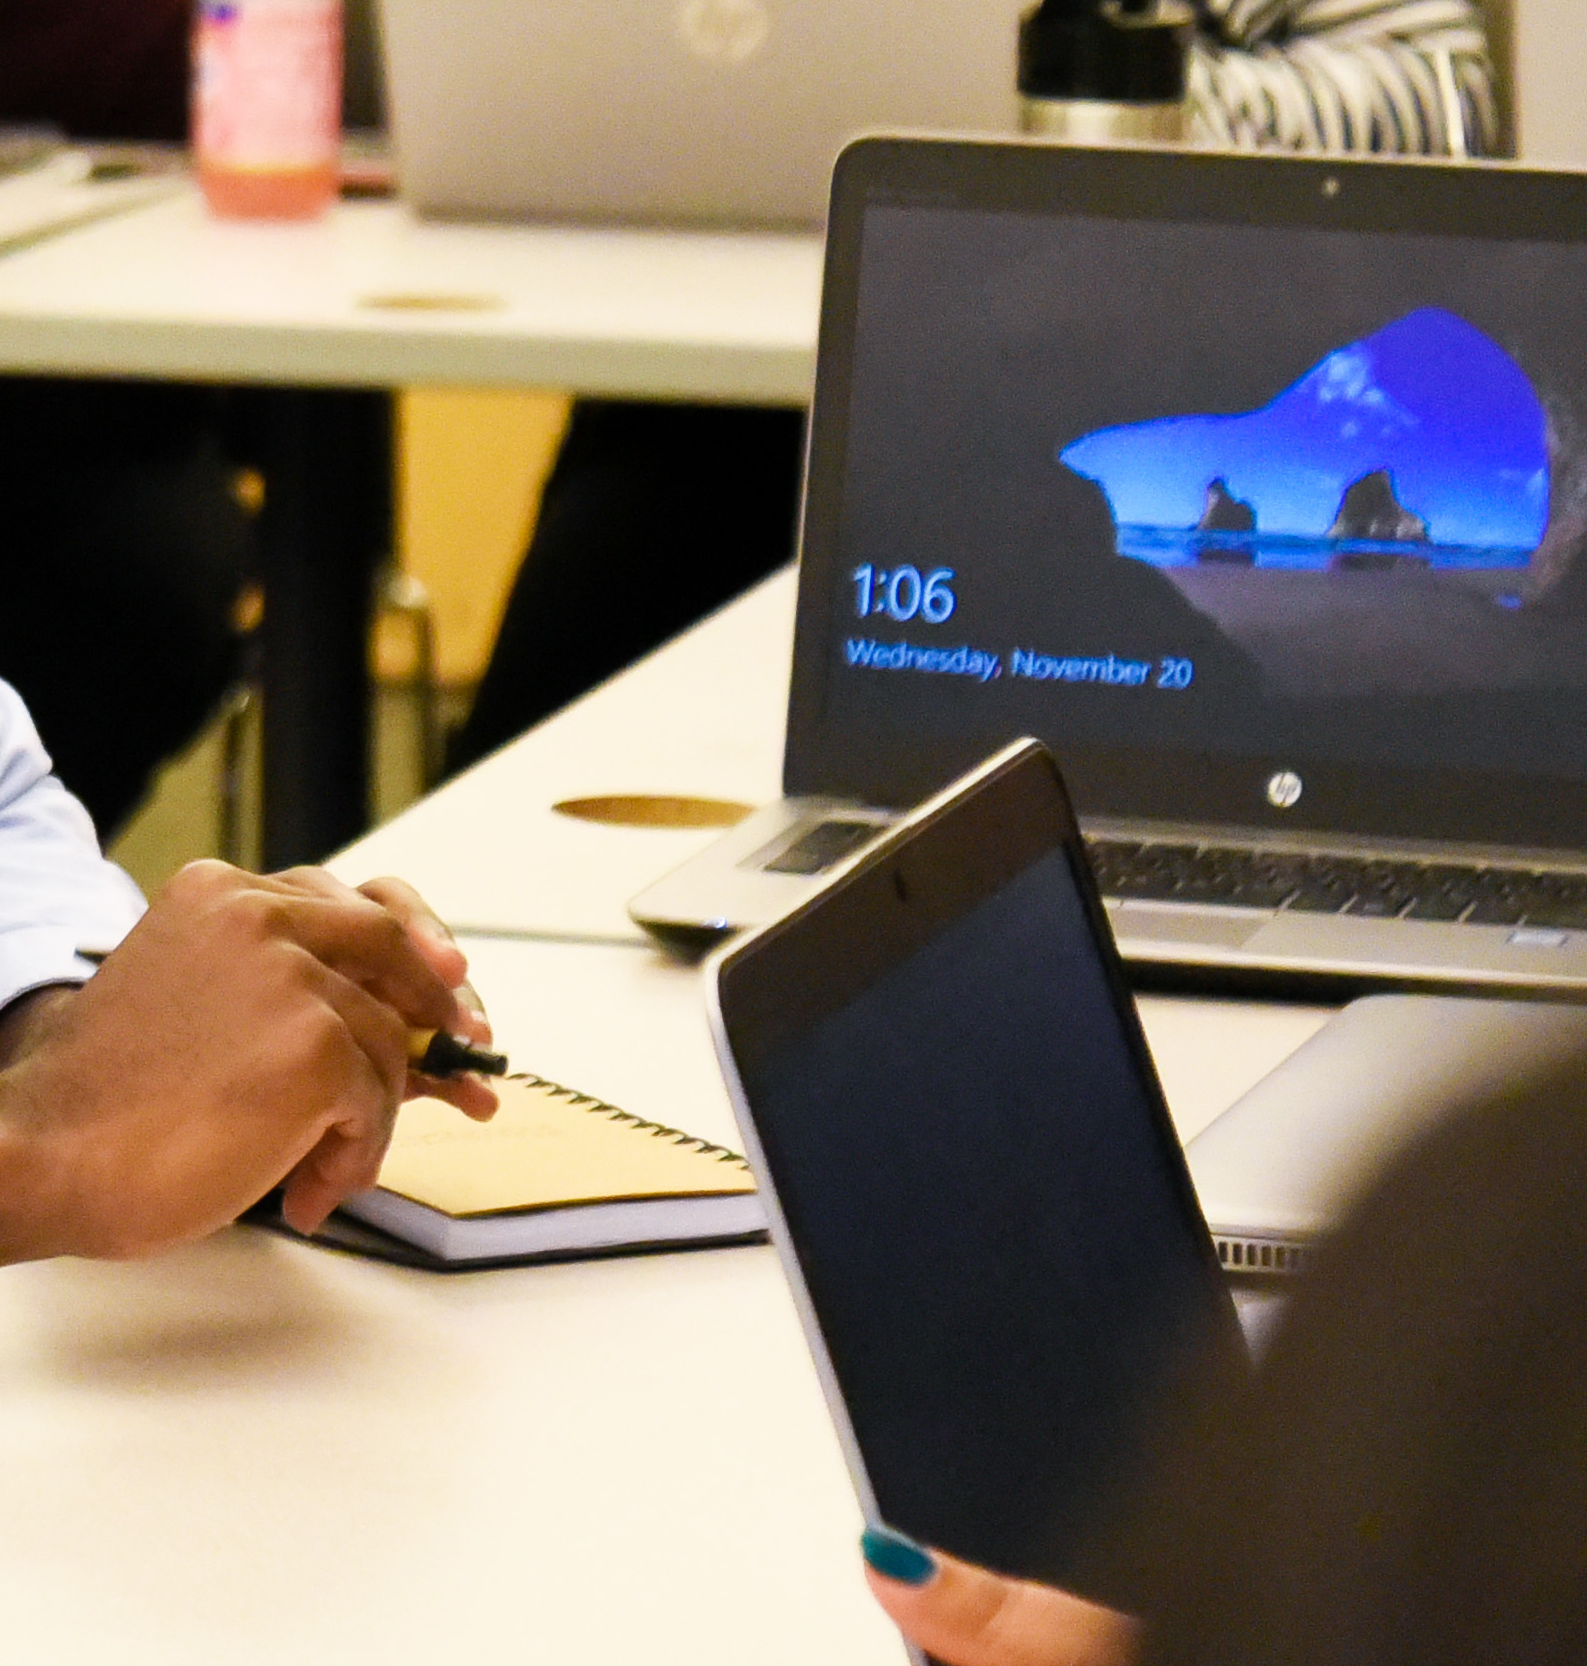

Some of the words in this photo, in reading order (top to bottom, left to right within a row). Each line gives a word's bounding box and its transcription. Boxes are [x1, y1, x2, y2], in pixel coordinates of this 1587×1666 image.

[852, 562, 957, 624] 1:06
[845, 636, 1002, 683] Wednesday,
[1011, 646, 1153, 685] November
[1157, 655, 1194, 690] 20
